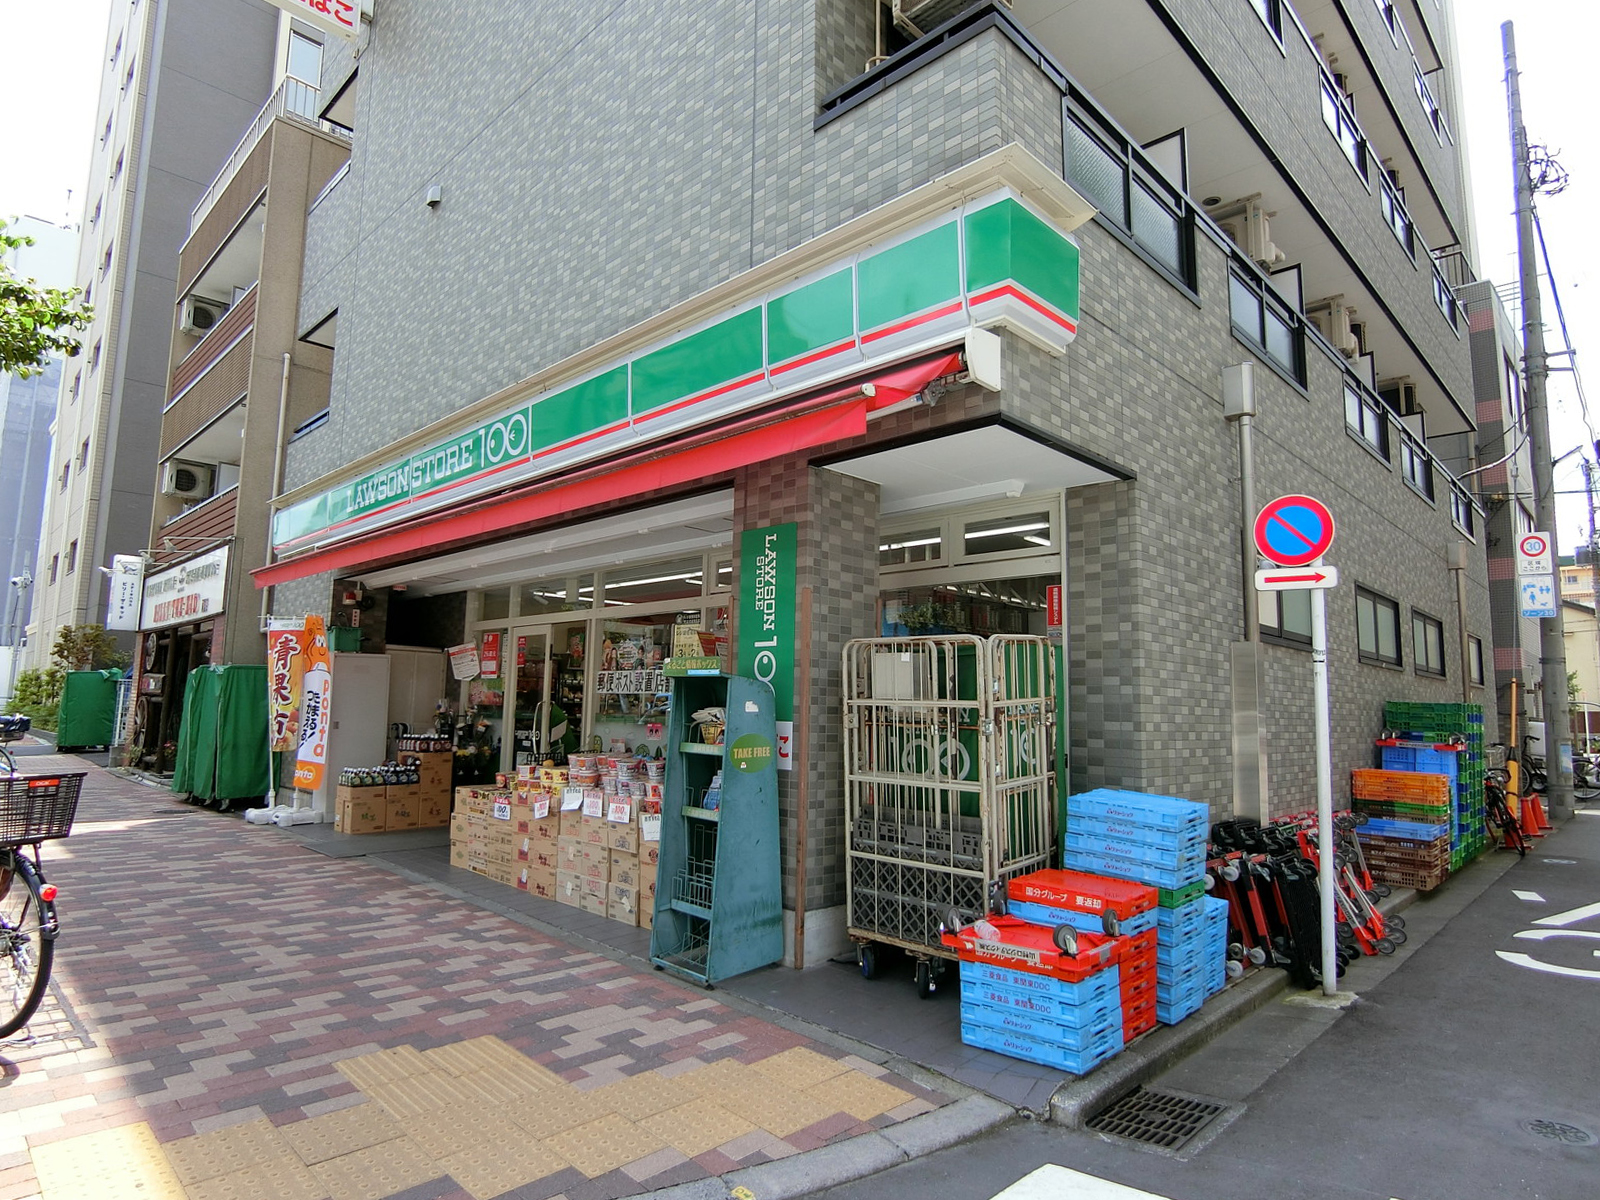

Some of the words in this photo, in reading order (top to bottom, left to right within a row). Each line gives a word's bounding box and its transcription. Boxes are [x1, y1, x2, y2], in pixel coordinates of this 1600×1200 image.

[346, 465, 409, 513] LAWSON
[412, 439, 473, 488] STORE
[478, 413, 528, 468] 100
[1525, 541, 1541, 552] 30
[755, 555, 765, 611] STORE
[763, 533, 777, 631] LAWSON
[753, 635, 777, 698] 10
[733, 747, 753, 759] TAKE
[753, 746, 771, 758] FREE
[295, 769, 313, 779] onta
[1025, 886, 1068, 902] 国分グループ
